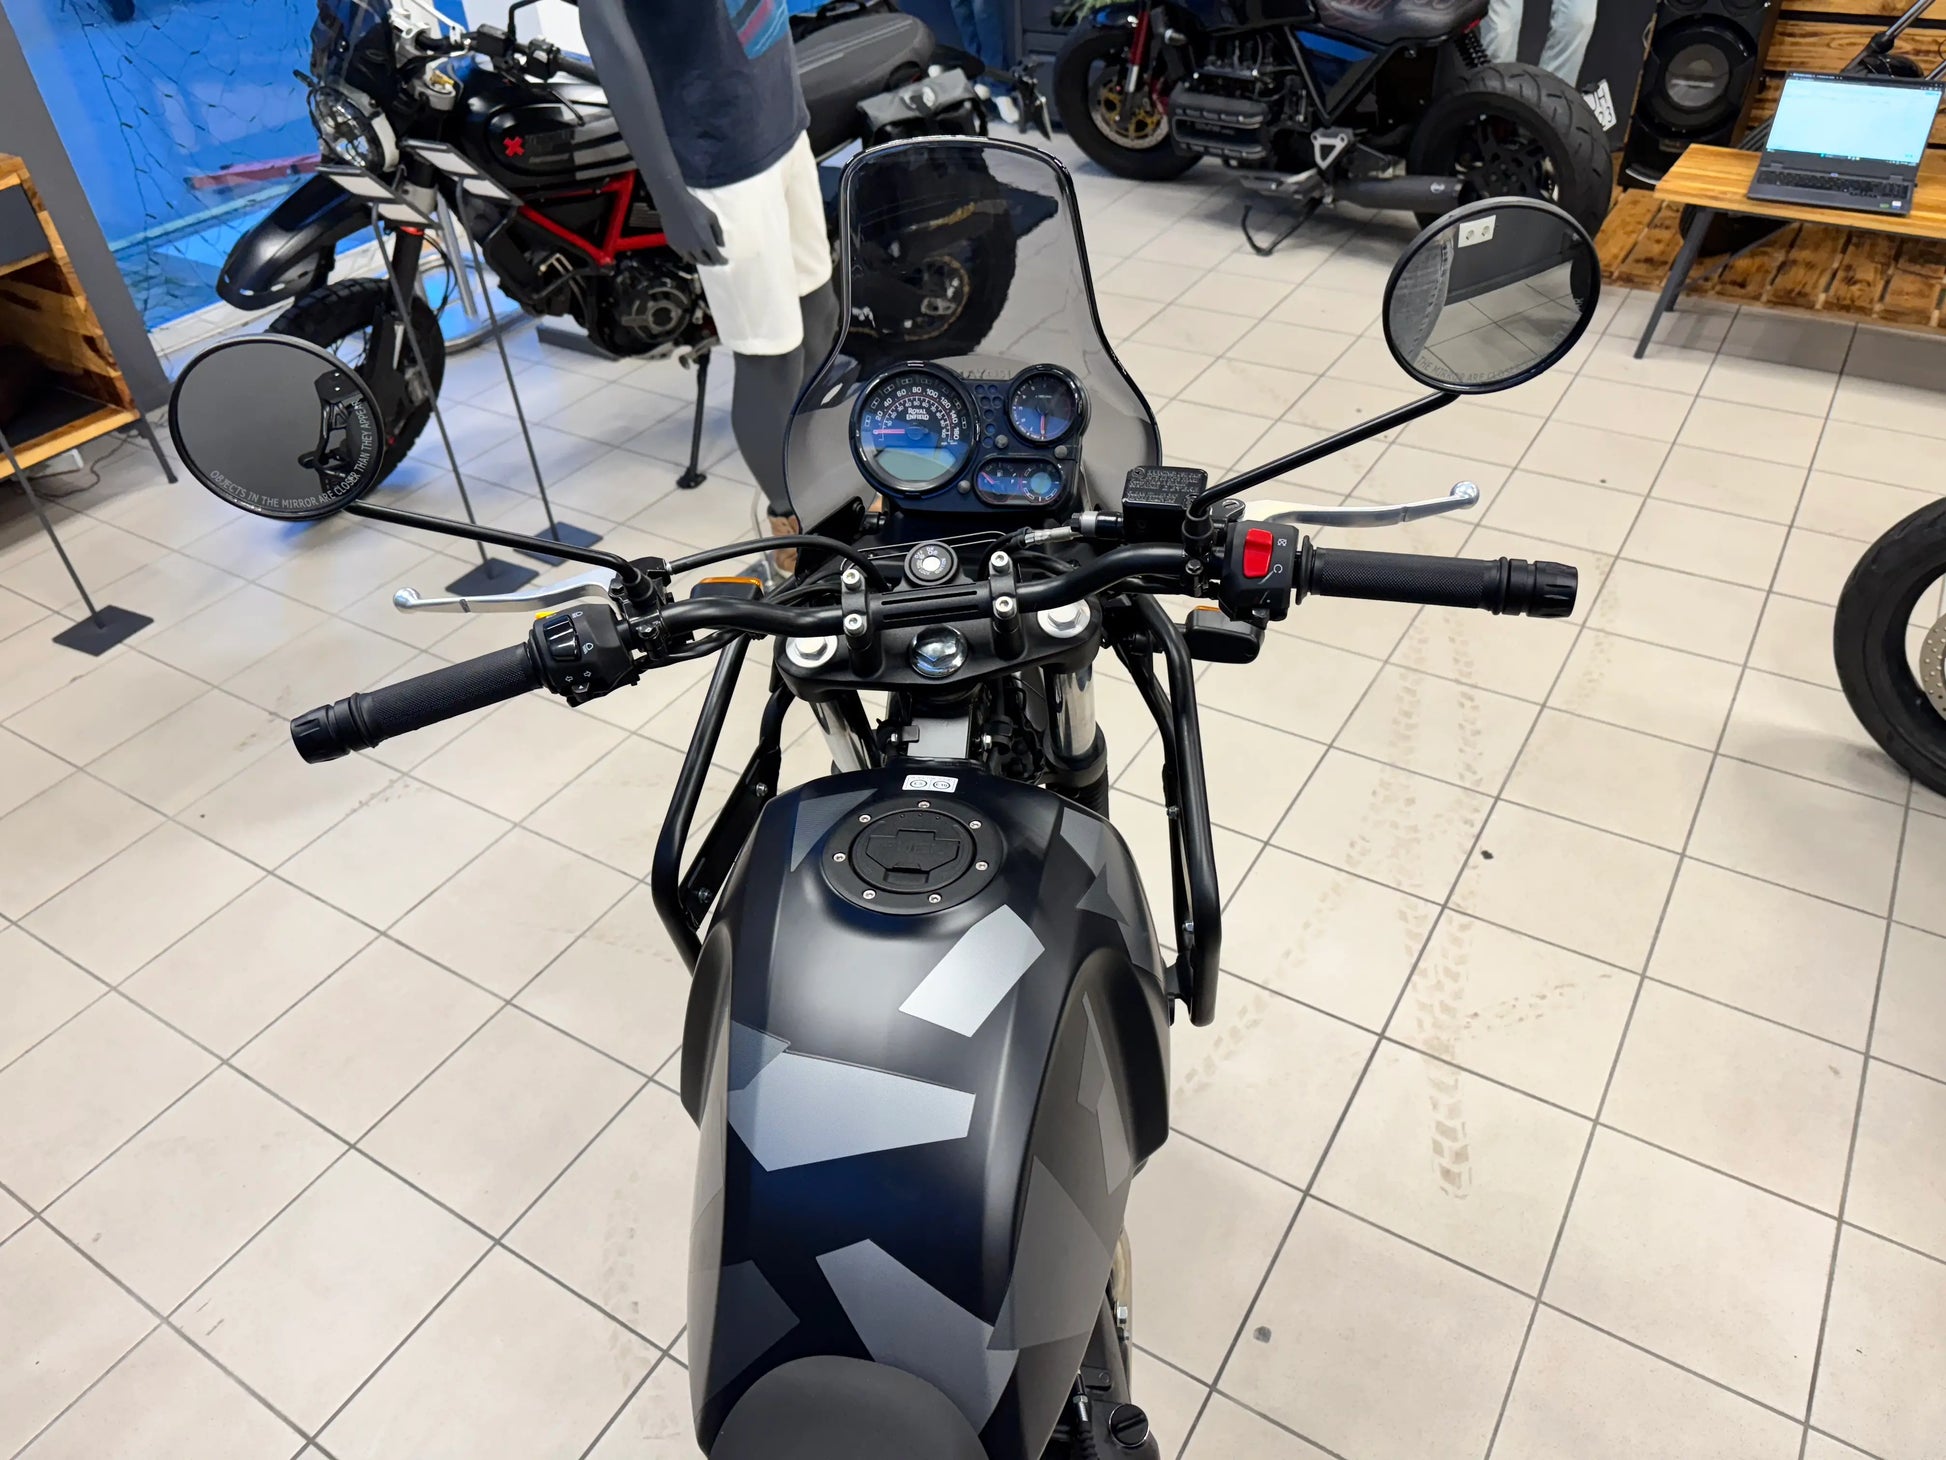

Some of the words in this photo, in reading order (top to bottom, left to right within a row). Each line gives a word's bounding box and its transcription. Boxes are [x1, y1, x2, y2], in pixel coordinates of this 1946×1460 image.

[875, 410, 883, 421] 20
[884, 397, 893, 407] 40
[896, 389, 907, 397] 60
[926, 388, 938, 398] 100
[940, 397, 951, 409] 120
[950, 410, 958, 424] 140
[361, 430, 373, 450] THEY
[354, 451, 371, 472] THAN
[209, 470, 247, 498] OBJECTS
[334, 471, 361, 496] CLOSER
[247, 491, 259, 503] IN
[261, 495, 280, 508] THE
[281, 497, 319, 510] MIRROR
[319, 490, 336, 506] ARE
